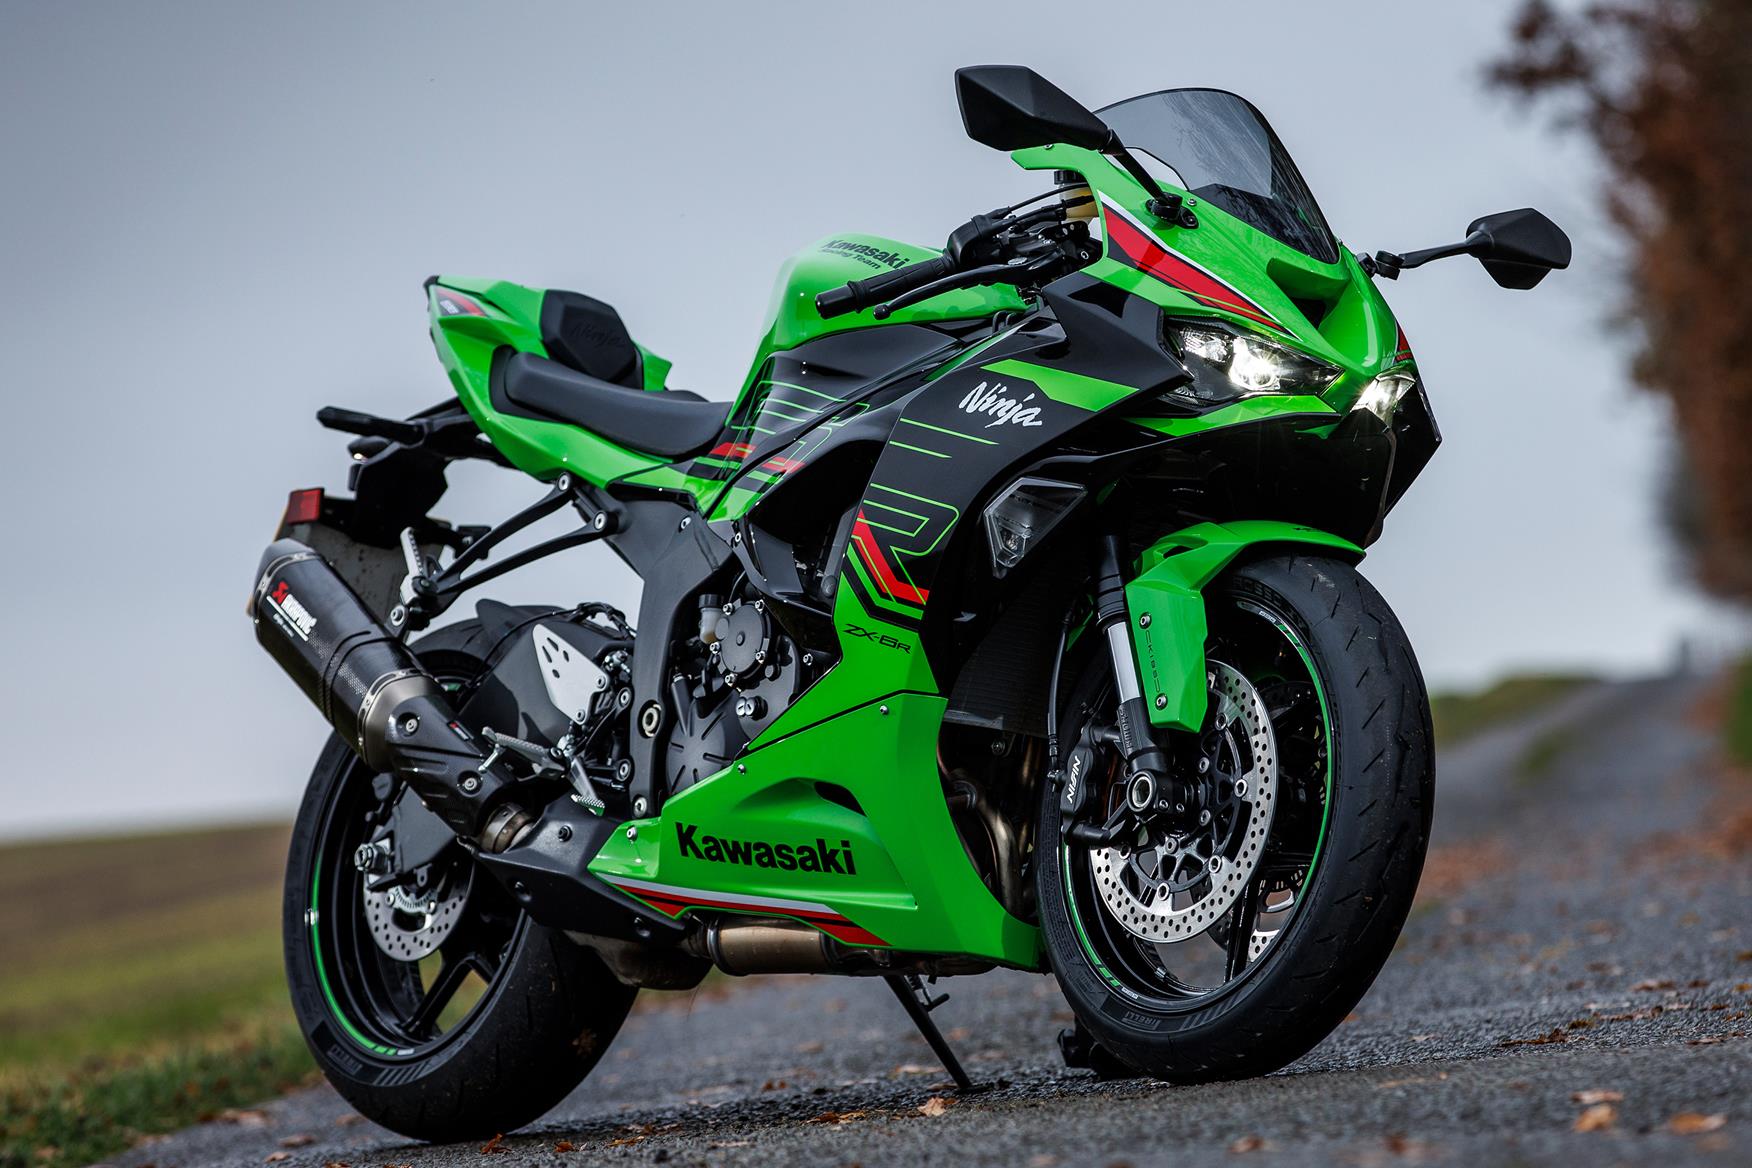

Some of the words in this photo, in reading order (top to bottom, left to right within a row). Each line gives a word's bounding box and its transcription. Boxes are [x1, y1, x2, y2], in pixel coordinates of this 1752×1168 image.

[821, 239, 910, 269] Kawasaki
[852, 253, 881, 270] Team
[958, 381, 1043, 428] Ninja
[843, 623, 912, 654] ZX-6R
[675, 821, 857, 876] Kawasaki
